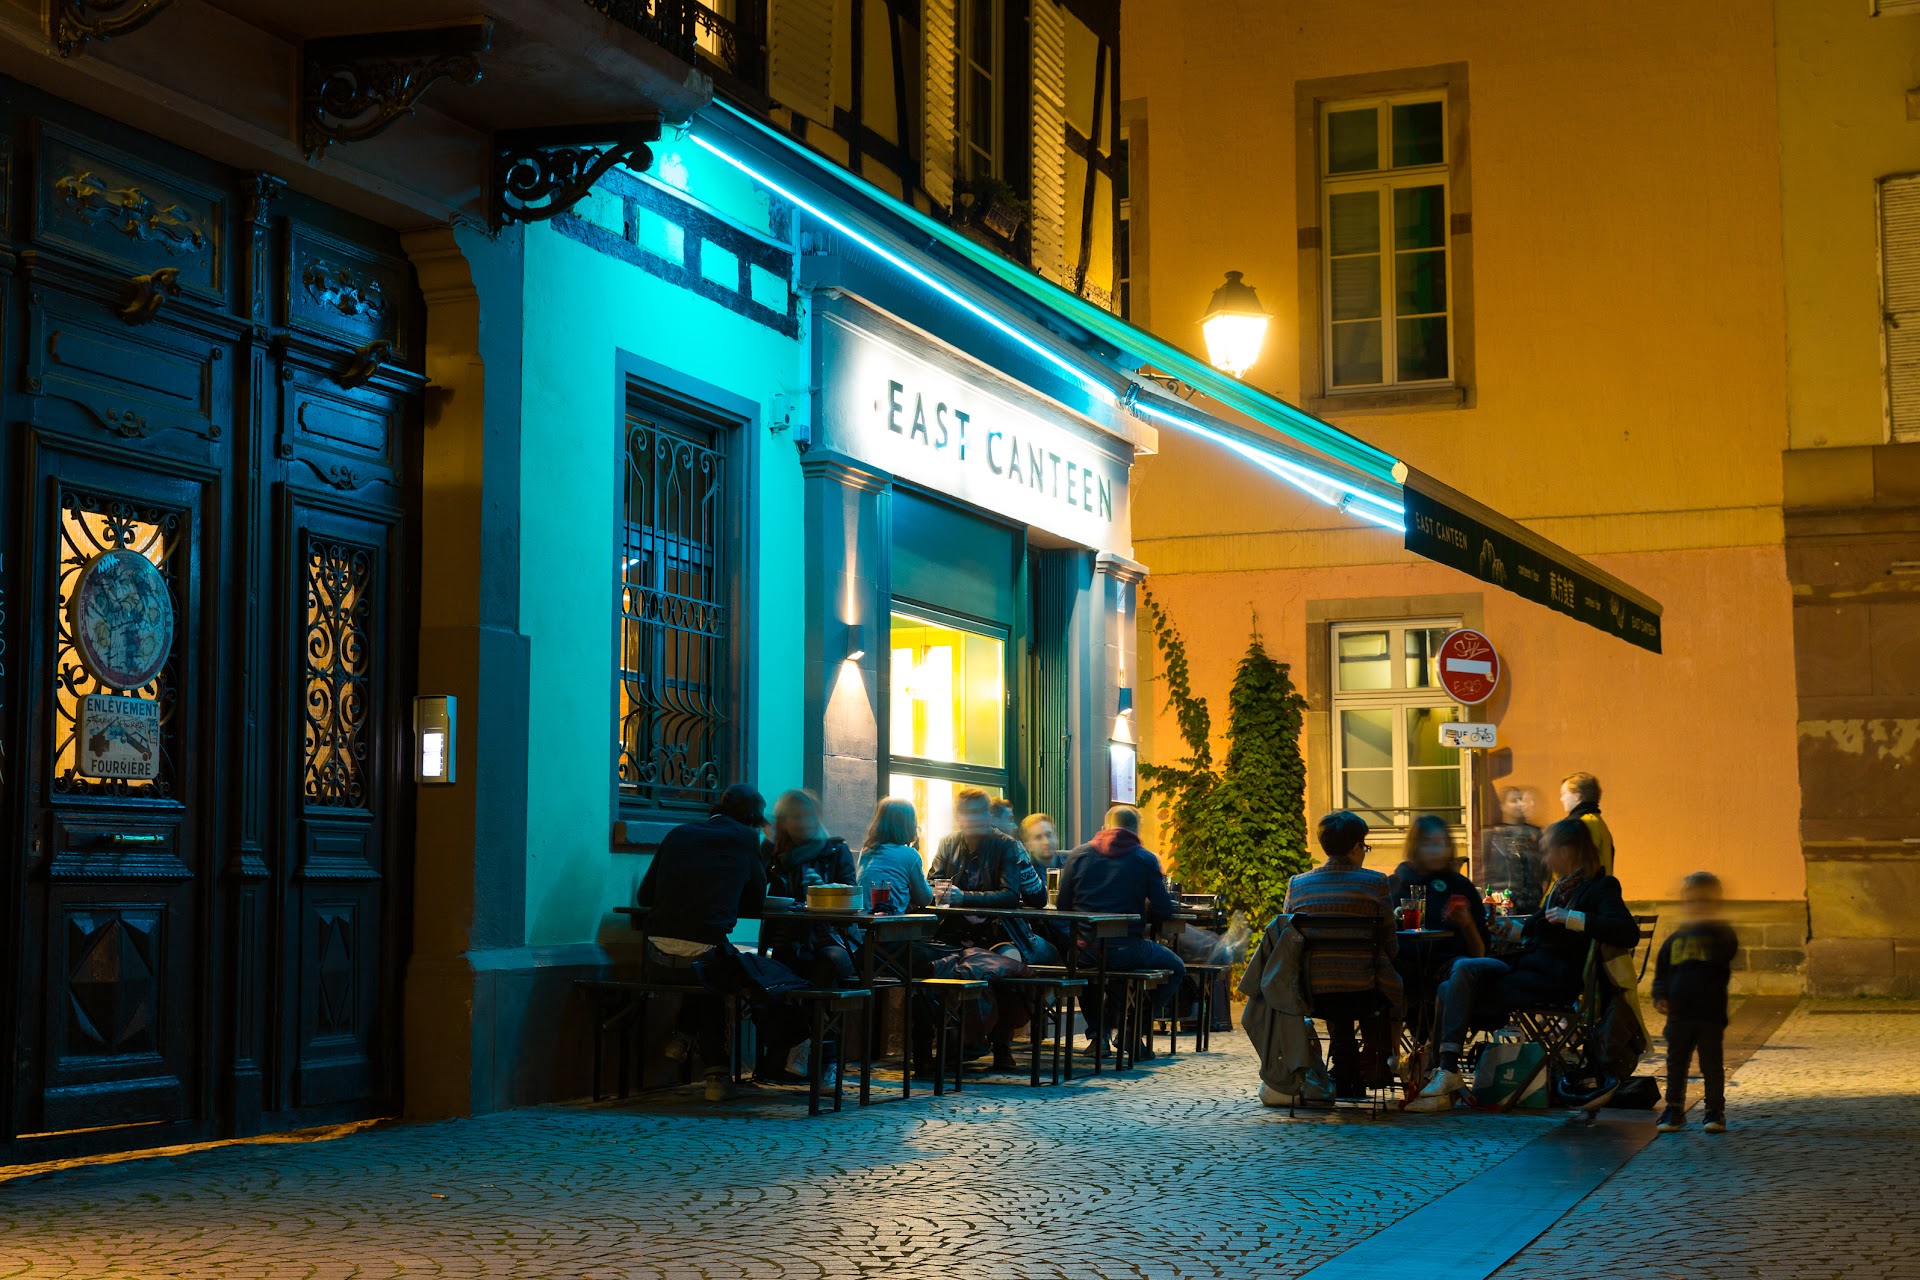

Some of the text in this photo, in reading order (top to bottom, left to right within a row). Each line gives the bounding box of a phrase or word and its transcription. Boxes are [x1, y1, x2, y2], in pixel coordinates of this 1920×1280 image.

[888, 379, 1113, 522] EAST CANTEEN
[1415, 512, 1468, 550] EAST CANTEEN
[87, 698, 159, 717] ENLÈVEMENT
[91, 758, 152, 776] FOURRIÈRE
